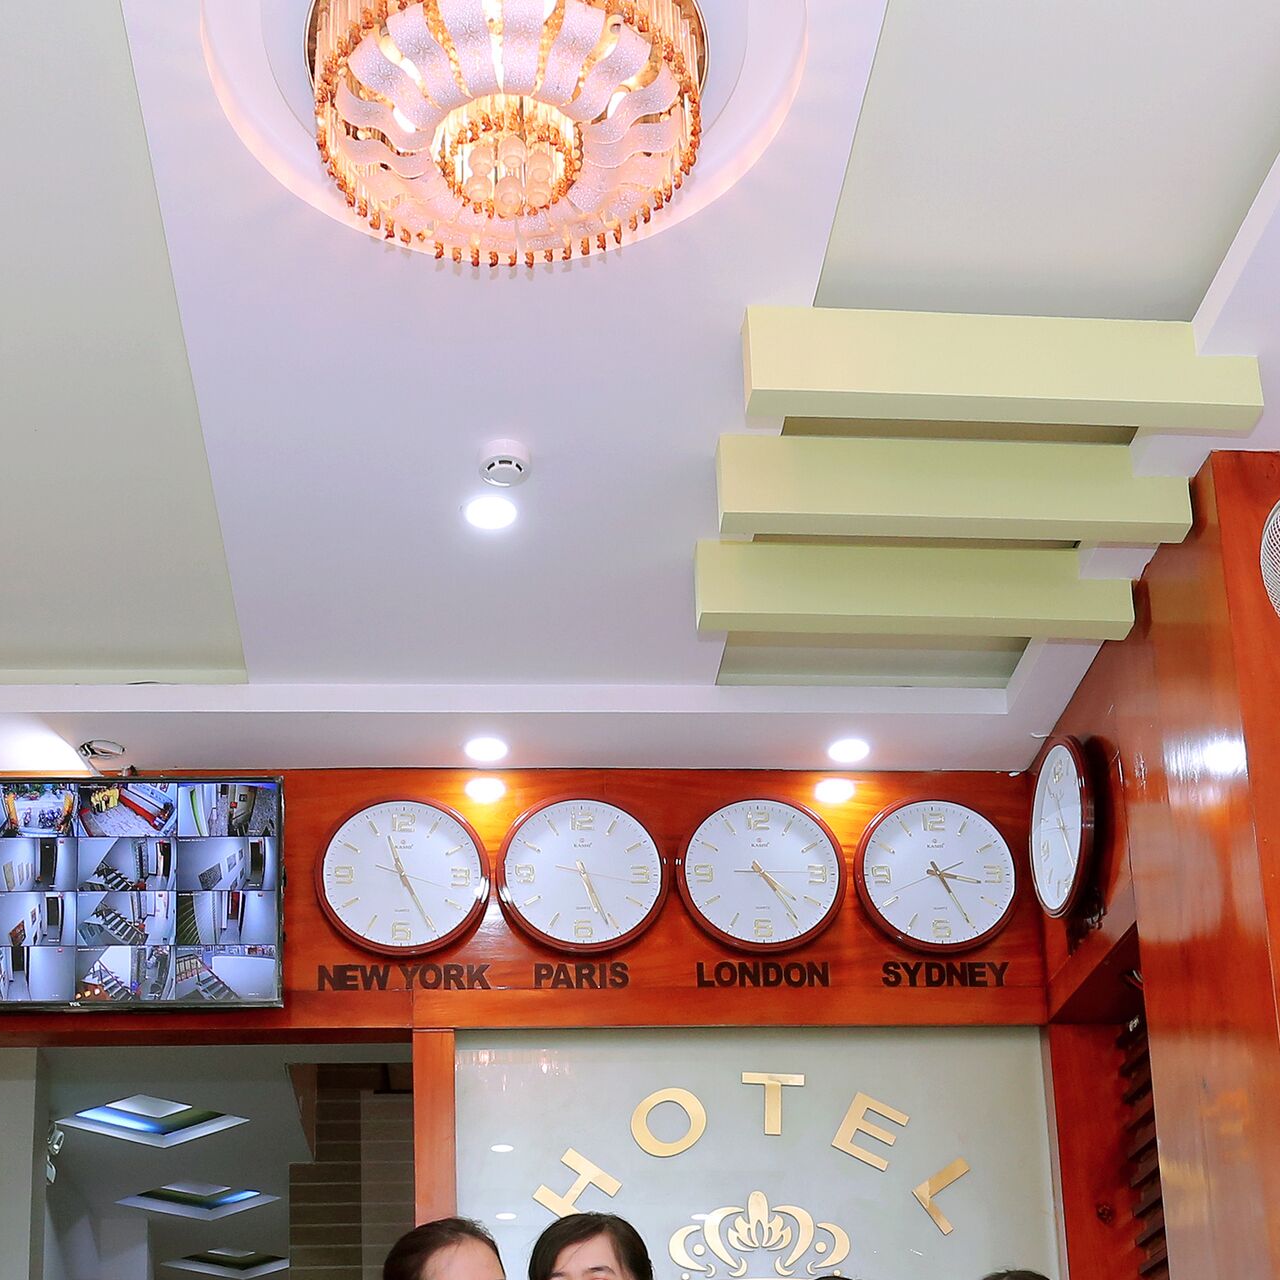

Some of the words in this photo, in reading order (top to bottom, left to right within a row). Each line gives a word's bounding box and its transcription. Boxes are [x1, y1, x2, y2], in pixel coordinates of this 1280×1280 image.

[317, 964, 391, 991] NEW
[398, 963, 491, 990] YORK
[534, 962, 630, 989] PARIS
[696, 962, 830, 988] LONDON
[881, 961, 1011, 988] SYDNEY
[532, 1071, 970, 1236] HOTEL
